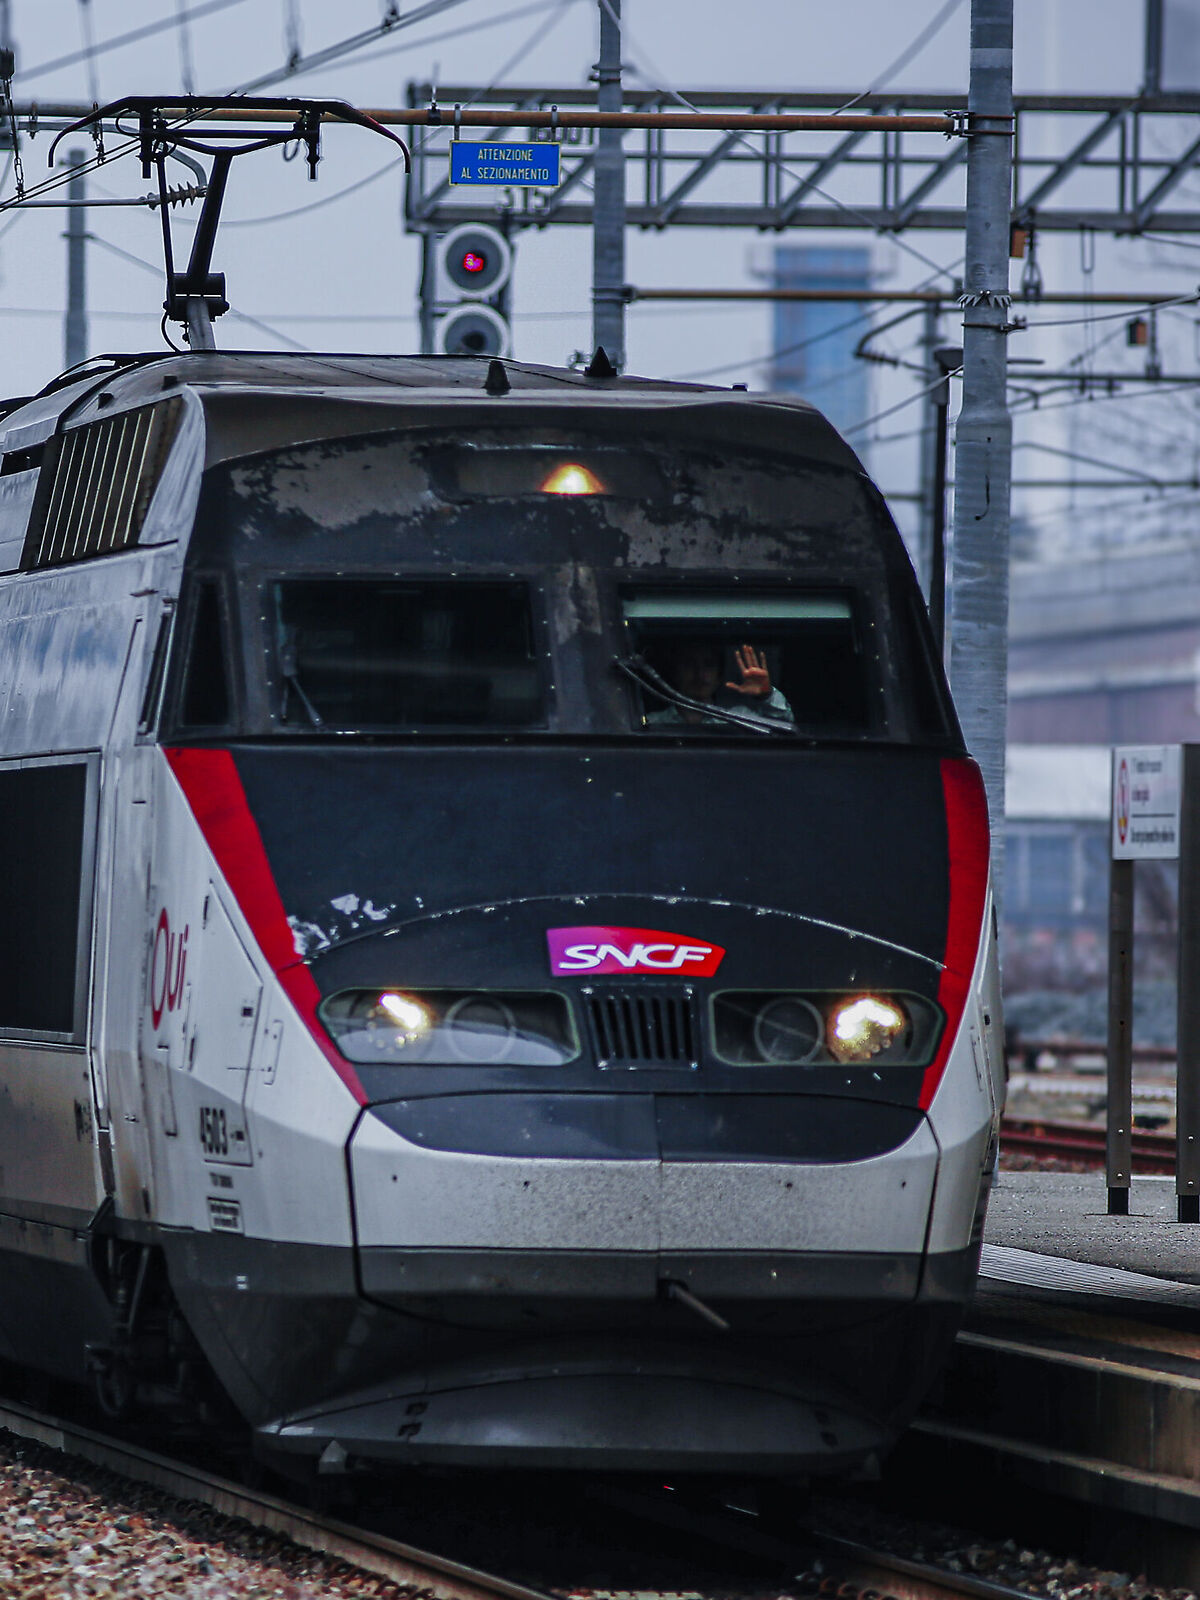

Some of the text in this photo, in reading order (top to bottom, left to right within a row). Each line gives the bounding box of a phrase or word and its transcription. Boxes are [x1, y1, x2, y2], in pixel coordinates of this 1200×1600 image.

[478, 149, 533, 161] ATTENZIONE
[461, 167, 549, 180] AL SEZIONAMENTO
[558, 943, 712, 969] SNCF
